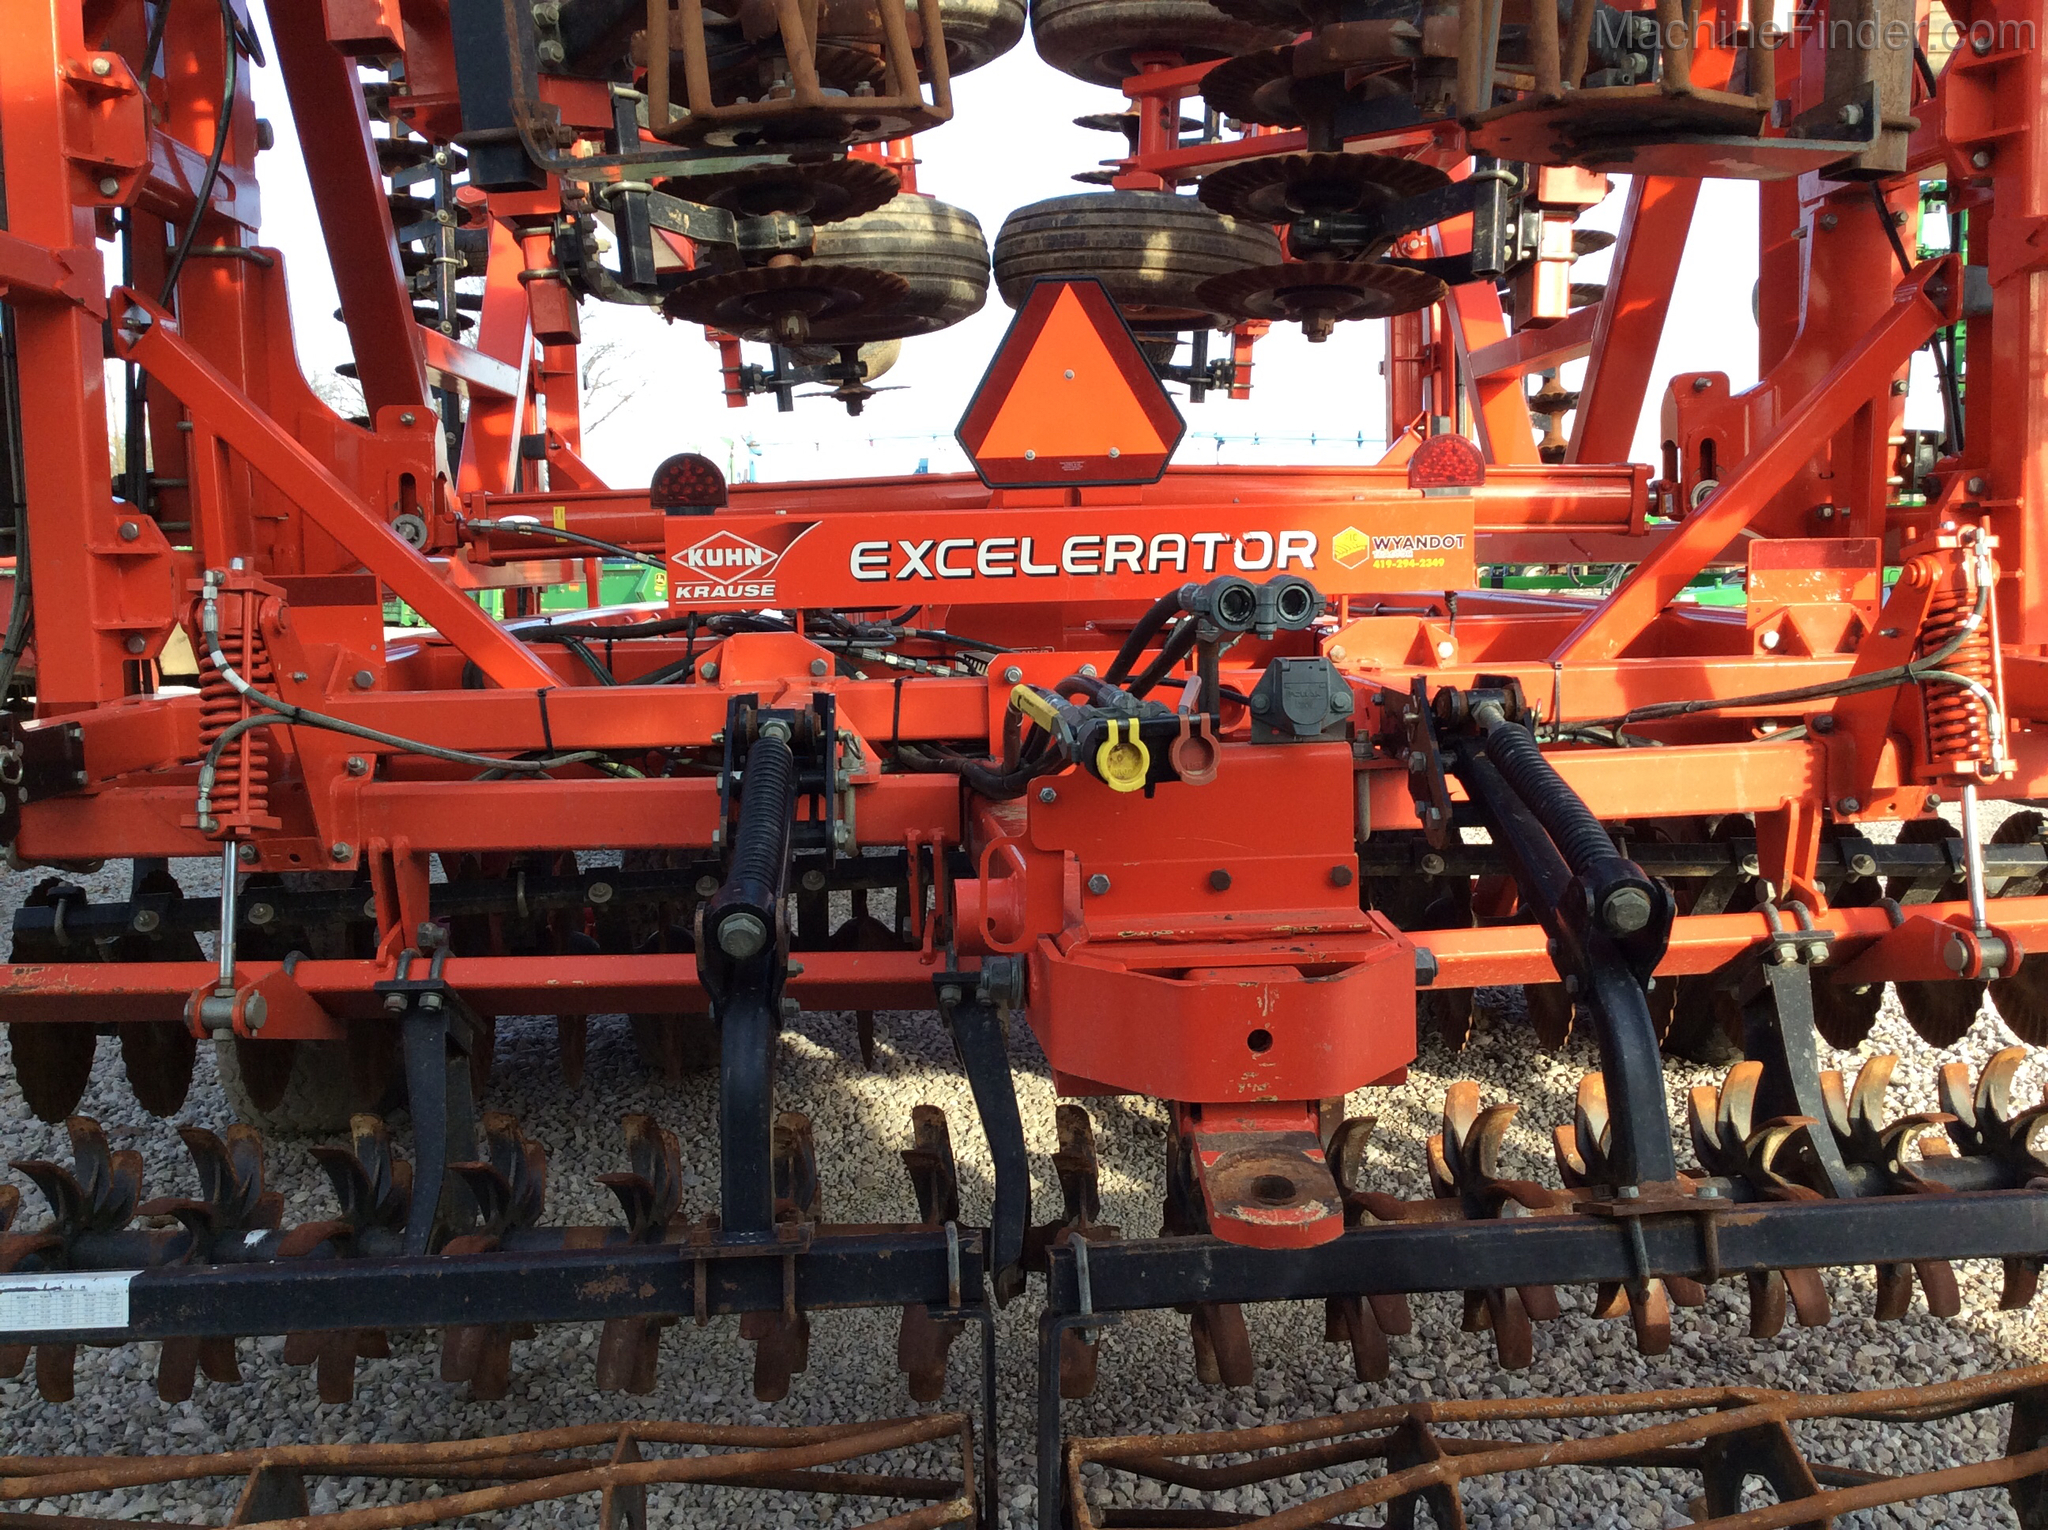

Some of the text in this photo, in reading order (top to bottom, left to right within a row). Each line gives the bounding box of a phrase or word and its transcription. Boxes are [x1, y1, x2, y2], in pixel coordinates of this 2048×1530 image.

[1373, 534, 1466, 551] WYANDOT
[687, 547, 762, 567] KUHN
[850, 529, 1317, 581] EXCELERATOR
[1373, 558, 1445, 569] 419-294-2349
[675, 584, 775, 599] KRAUSE
